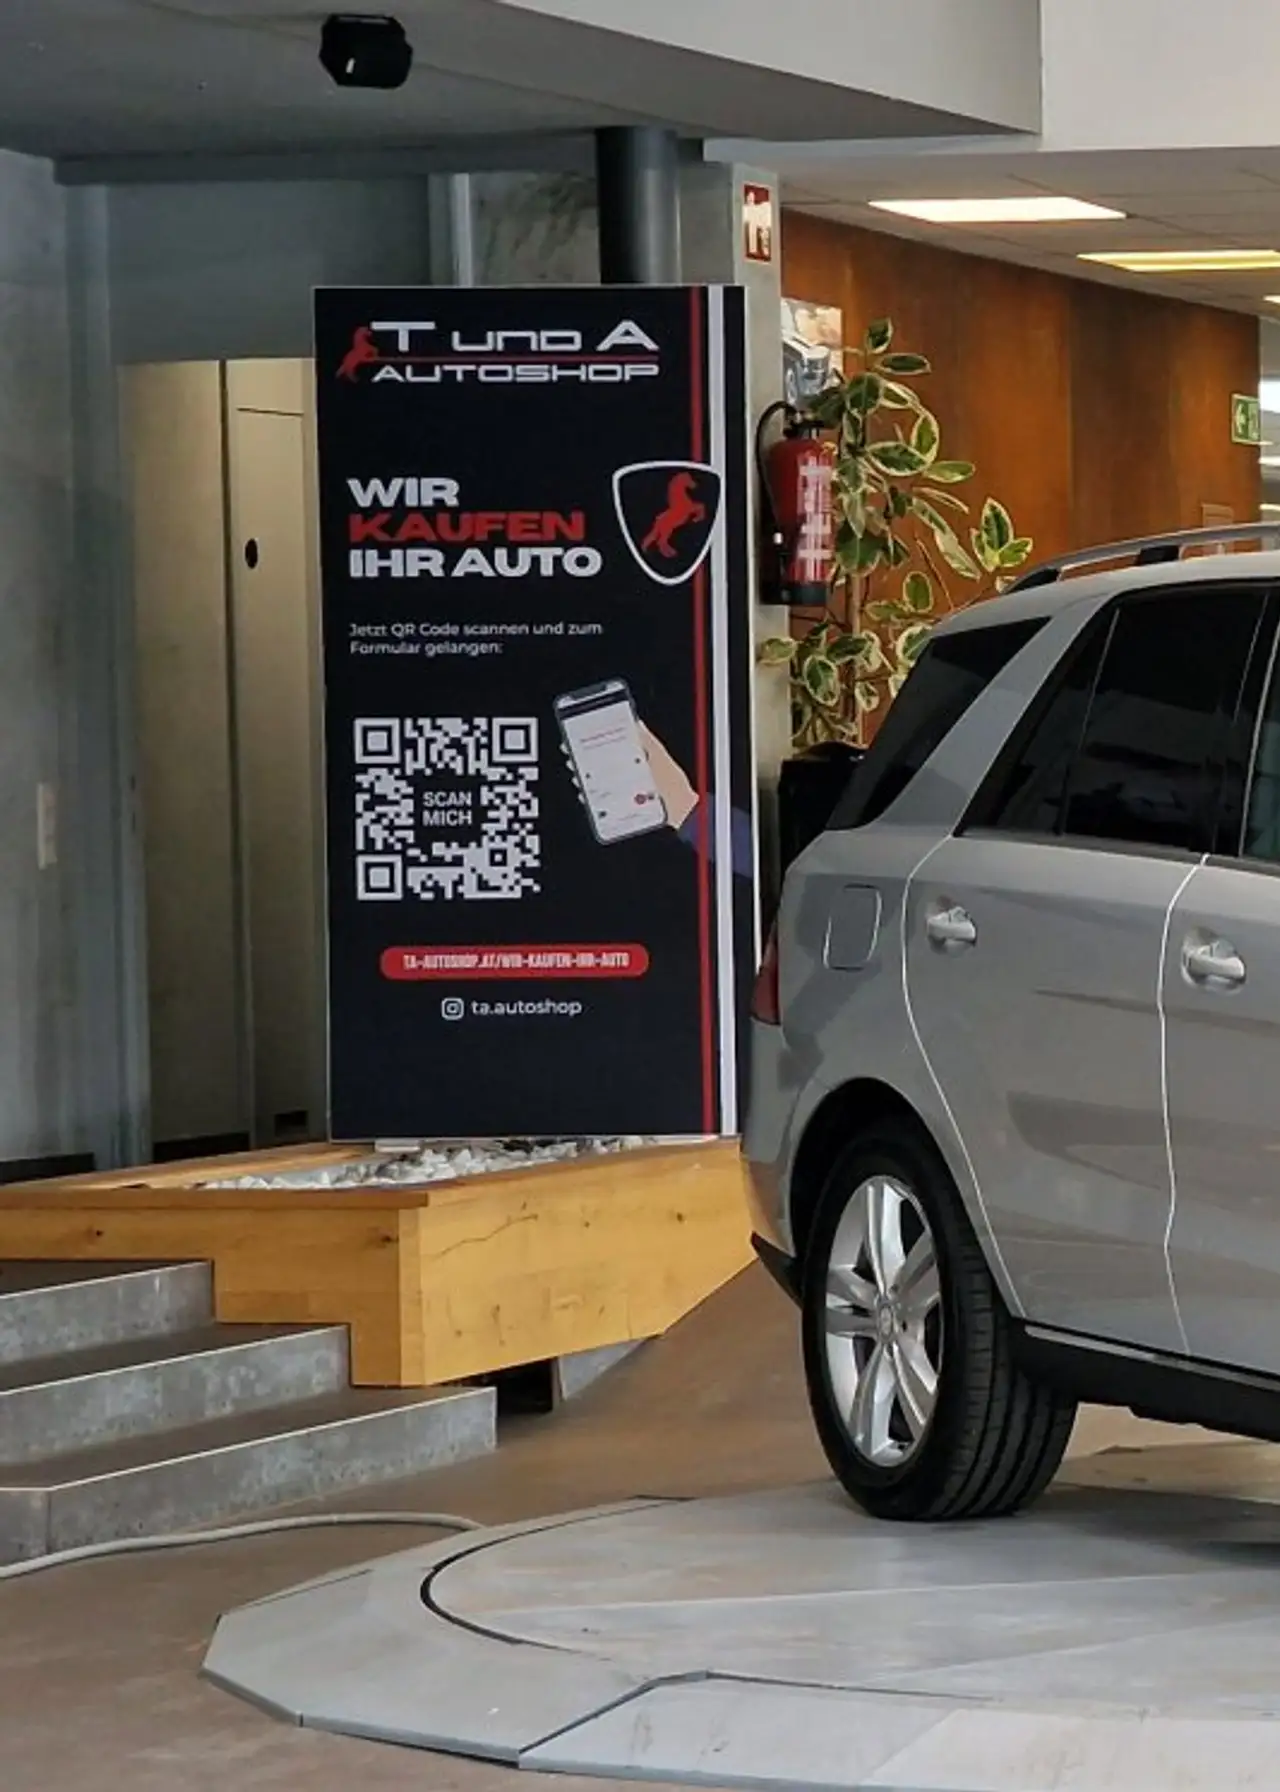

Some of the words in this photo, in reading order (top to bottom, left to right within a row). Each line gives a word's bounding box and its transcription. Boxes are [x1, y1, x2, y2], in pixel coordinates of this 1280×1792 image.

[369, 321, 435, 352] T
[597, 319, 659, 351] A
[372, 363, 660, 383] AUTOSHOP
[347, 477, 460, 508] WIR
[349, 511, 586, 543] KAUFEN
[349, 549, 445, 577] IHR
[451, 546, 602, 577] AUTO
[350, 623, 387, 637] Jetzt
[391, 623, 416, 638] QR
[419, 622, 460, 637] Code
[463, 624, 530, 636] scannen
[532, 621, 565, 635] und
[568, 623, 603, 635] zum
[350, 641, 420, 655] Formular
[425, 641, 503, 657] gelangen:
[423, 791, 472, 807] SCAN
[423, 809, 472, 827] MICH
[403, 952, 631, 970] TA-AUTOSHOP.AT/WIR-KAUFEN-IHR-AUTO
[472, 1000, 582, 1017] ta.autoshop
